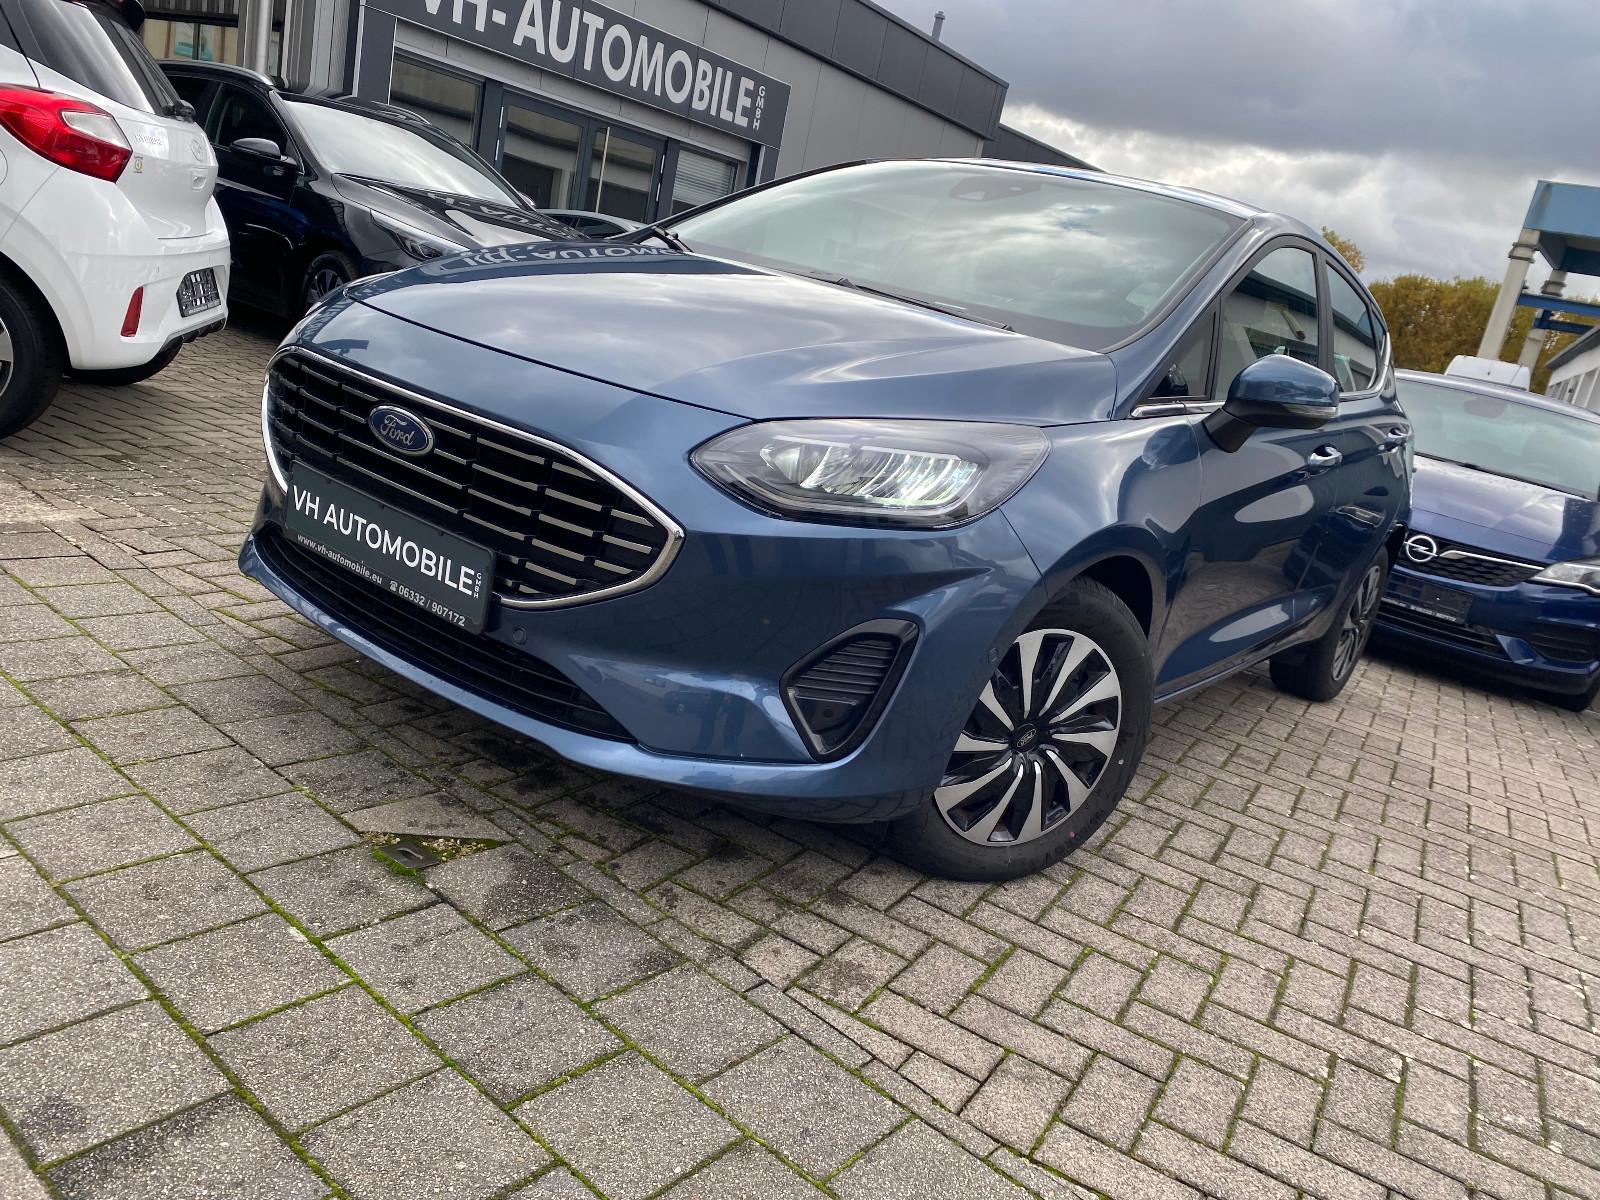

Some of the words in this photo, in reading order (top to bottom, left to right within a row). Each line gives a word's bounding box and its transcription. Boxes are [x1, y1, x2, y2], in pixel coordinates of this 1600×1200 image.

[424, 0, 755, 128] H-AUTOMOBILE
[752, 85, 766, 131] GMBH
[380, 414, 416, 446] Ford
[293, 485, 320, 520] VH
[323, 503, 475, 596] AUTOMOBILE
[297, 534, 383, 585] www.vh-automobile.eu
[398, 585, 426, 606] 06332
[431, 602, 466, 627] 907172
[473, 572, 482, 599] GMBH
